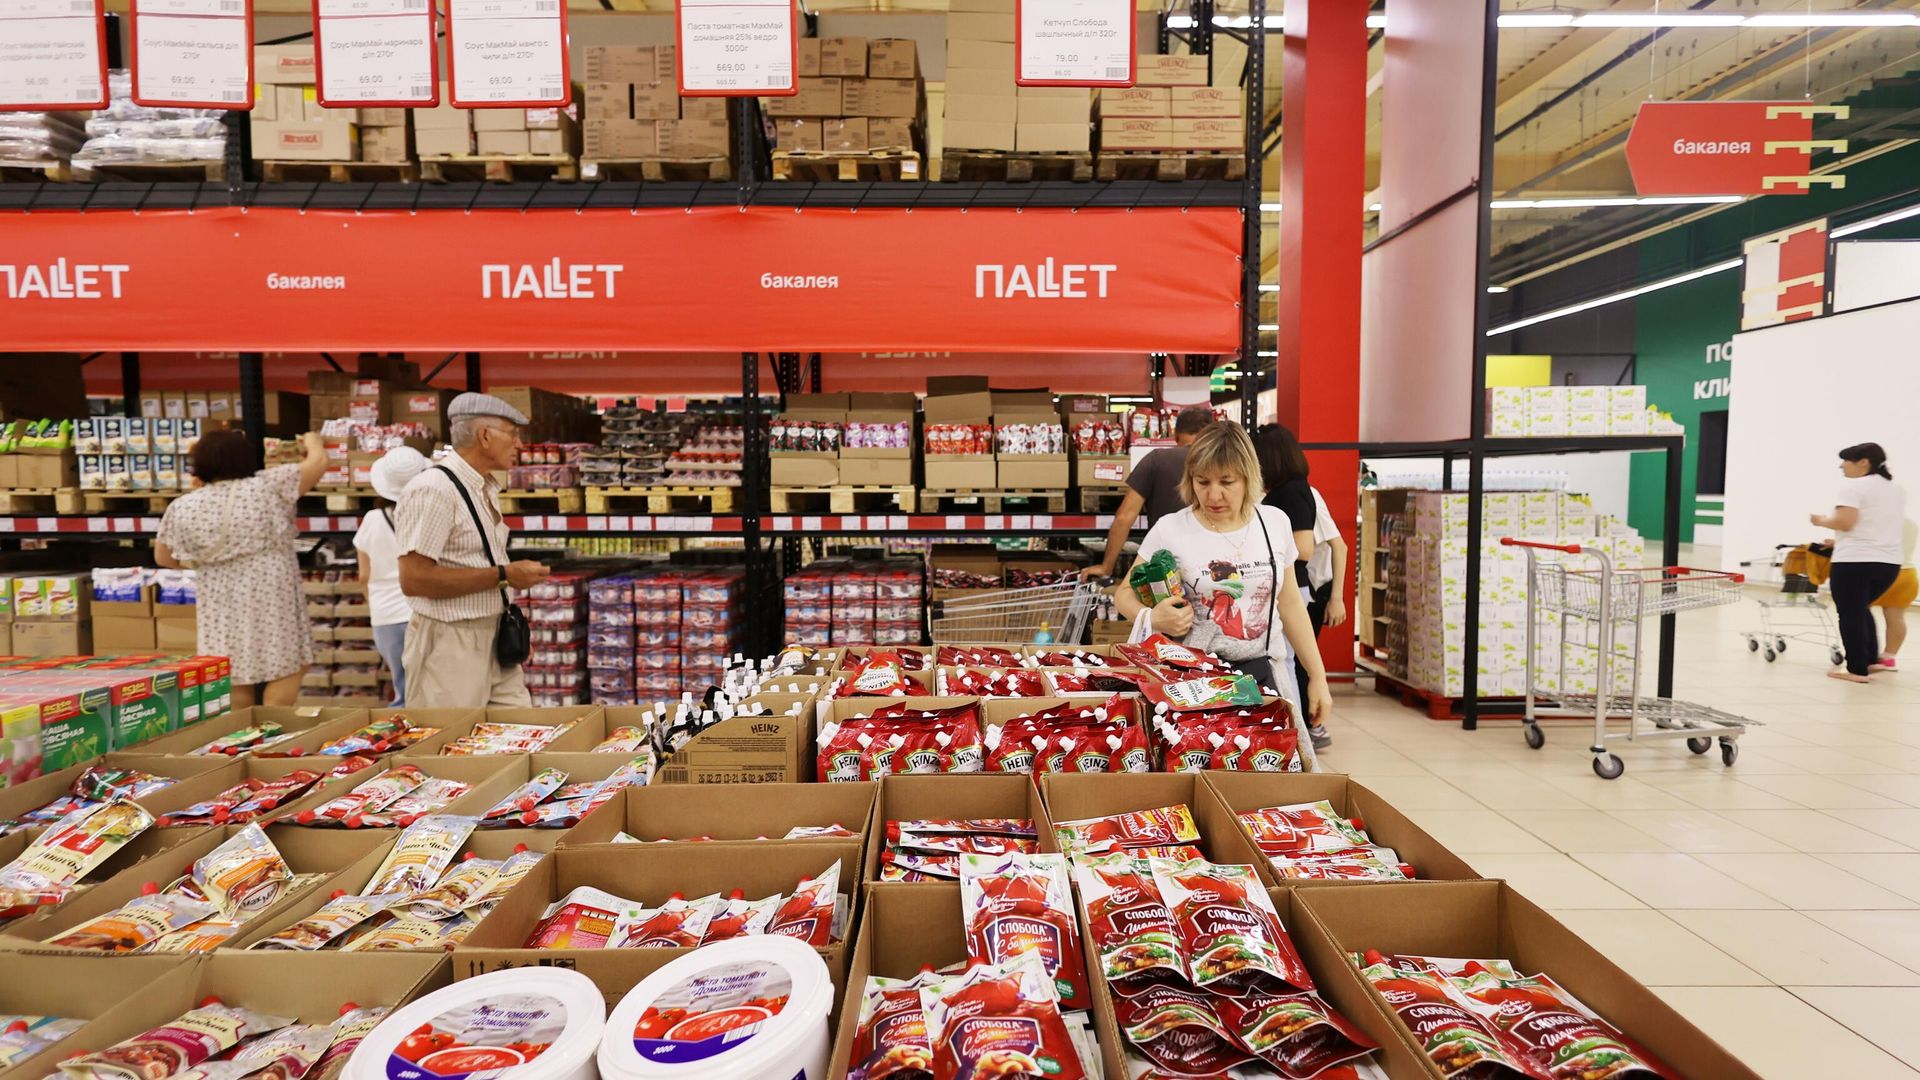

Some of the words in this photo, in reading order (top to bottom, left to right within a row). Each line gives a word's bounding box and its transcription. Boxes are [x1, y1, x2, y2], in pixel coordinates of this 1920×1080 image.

[1044, 19, 1071, 28] Кетчуп
[1073, 18, 1107, 27] Слобода
[1035, 30, 1082, 38] шашлычный
[330, 41, 349, 50] Соус
[384, 39, 423, 48] маринара
[465, 42, 485, 50] Соус
[518, 42, 540, 50] манго
[377, 51, 394, 59] 270г
[517, 51, 534, 59] 270г
[359, 75, 383, 84] 69.00
[489, 76, 512, 85] 69.00
[1673, 139, 1751, 155] бакалея
[266, 272, 345, 290] бакалея
[760, 272, 839, 289] бакалея
[120, 704, 144, 715] КАША
[751, 724, 780, 734] HEINZ
[838, 754, 860, 769] HEIN
[911, 755, 938, 768] HEINZ
[1082, 757, 1108, 771] HEINZ
[1125, 908, 1170, 920] СЛОБОДА
[999, 922, 1046, 936] СЛОБОДА
[689, 977, 719, 989] Паста
[721, 970, 767, 984] томатная
[505, 1009, 549, 1020] томатная
[1410, 1006, 1463, 1019] СЛОБОДА
[890, 1013, 924, 1026] СЛОБО
[1529, 1016, 1584, 1031] СЛОБОДА
[964, 1020, 1020, 1033] СЛОБОДА
[653, 1044, 677, 1056] 3000г
